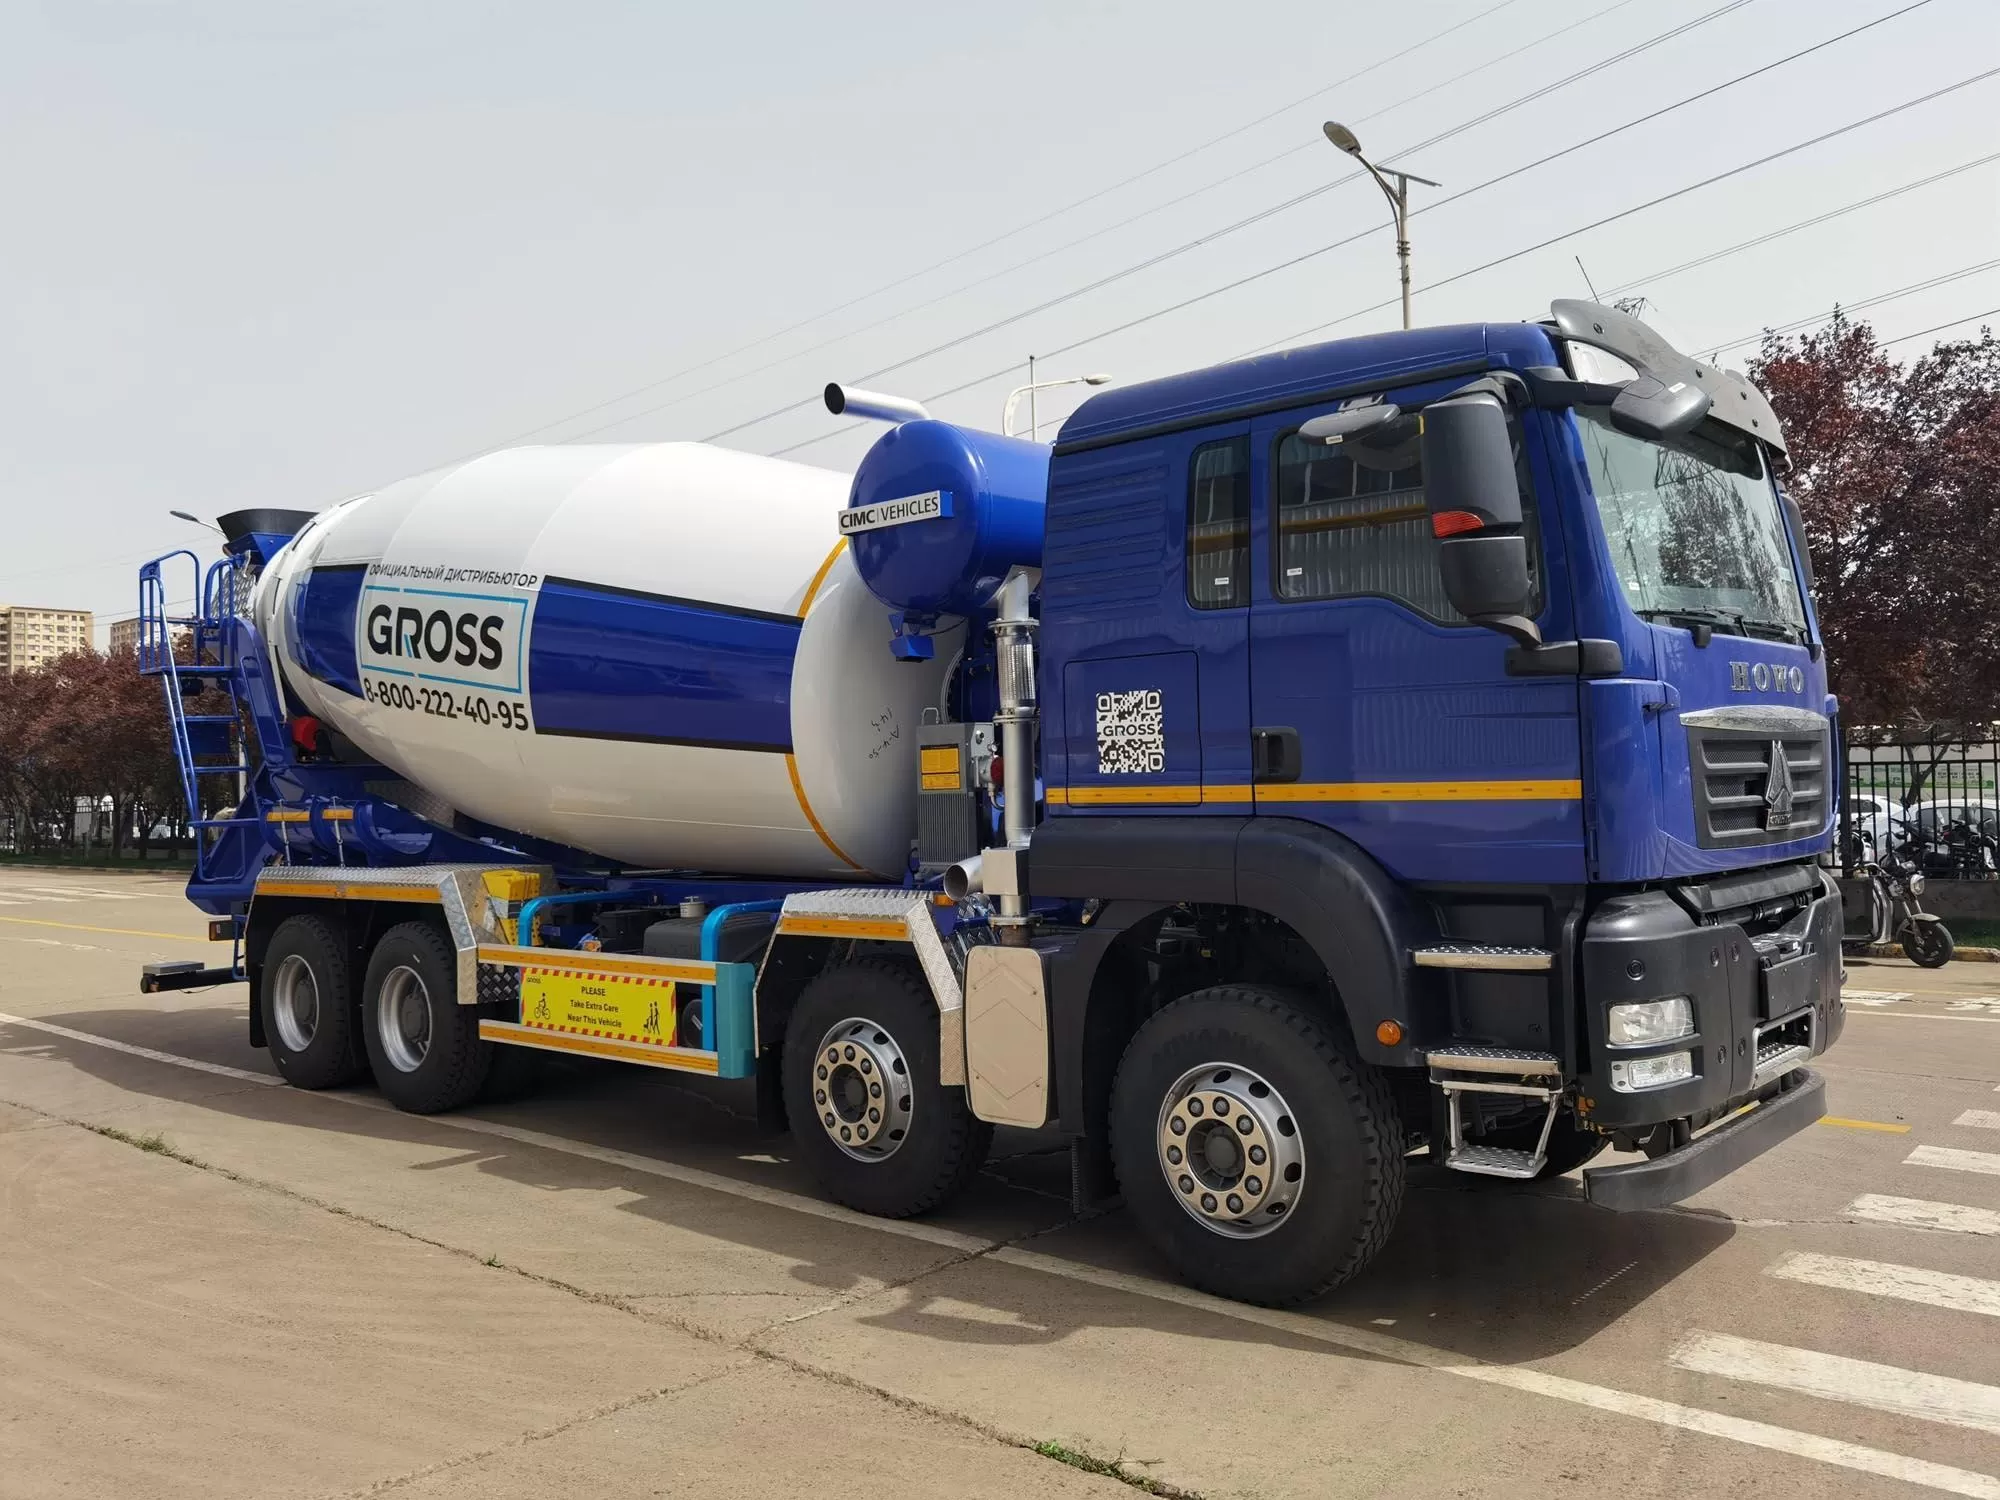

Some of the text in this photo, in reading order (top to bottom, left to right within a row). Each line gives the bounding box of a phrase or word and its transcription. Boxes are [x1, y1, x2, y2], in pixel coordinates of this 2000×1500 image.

[841, 497, 939, 528] CIMC VEHICLES
[369, 564, 538, 588] ОФИЦИАЛЬНЫЙ ДИСТРИБЬЮТОР
[367, 604, 505, 671] GROSS
[1729, 661, 1805, 694] HOWO
[364, 677, 529, 731] 8-800-222-40-95
[1103, 723, 1156, 737] GROSS
[581, 986, 606, 996] PLEASE
[570, 1000, 619, 1013] Take Extra Care
[567, 1013, 622, 1028] Near This Vehicle
